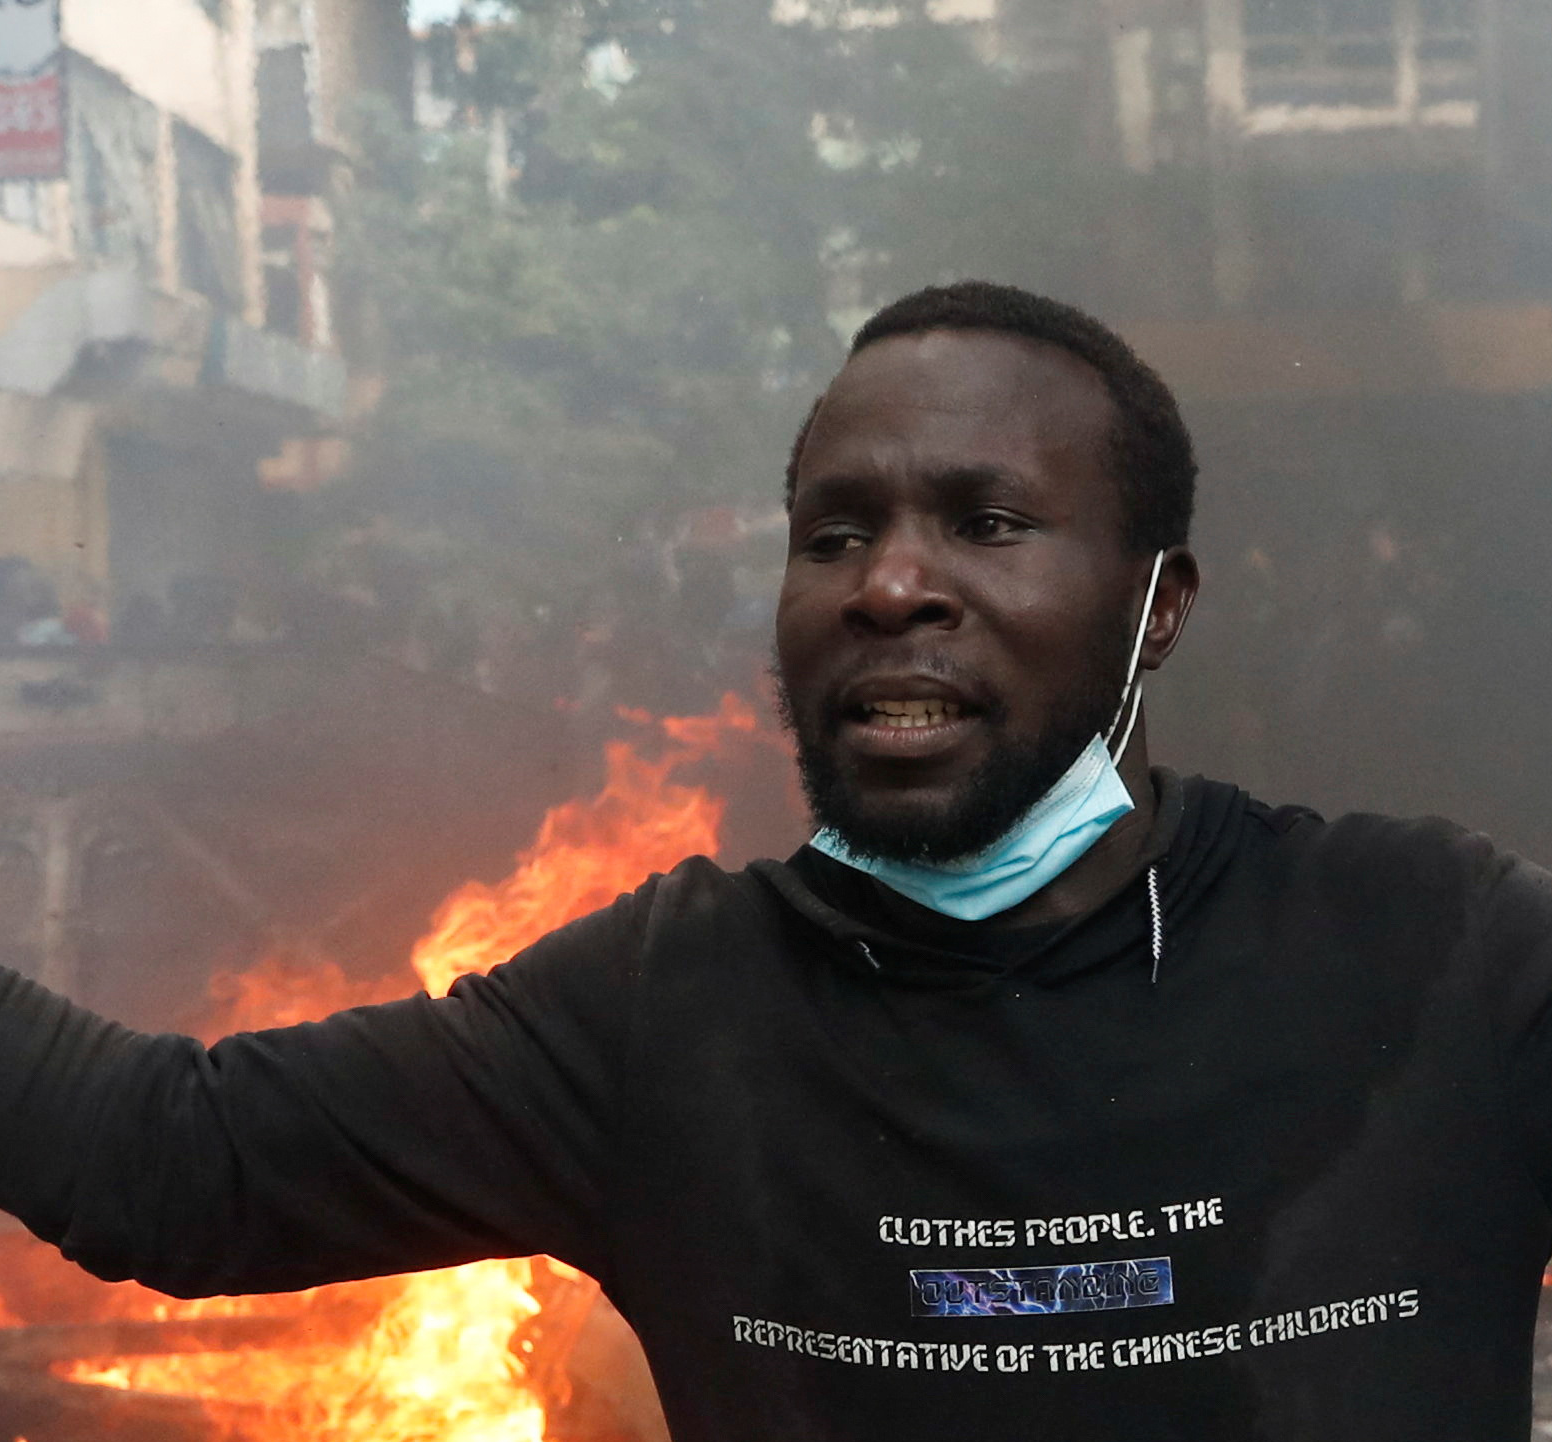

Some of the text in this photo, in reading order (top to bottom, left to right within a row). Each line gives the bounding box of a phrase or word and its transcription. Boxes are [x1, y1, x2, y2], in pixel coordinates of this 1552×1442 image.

[879, 1197, 1224, 1247] CLOTHES PEOPLE. THE
[921, 1269, 1160, 1306] OUTSTANDING
[733, 1289, 1419, 1373] REPRESENTATIVE OF THE CHINESE CHILDREN'S
